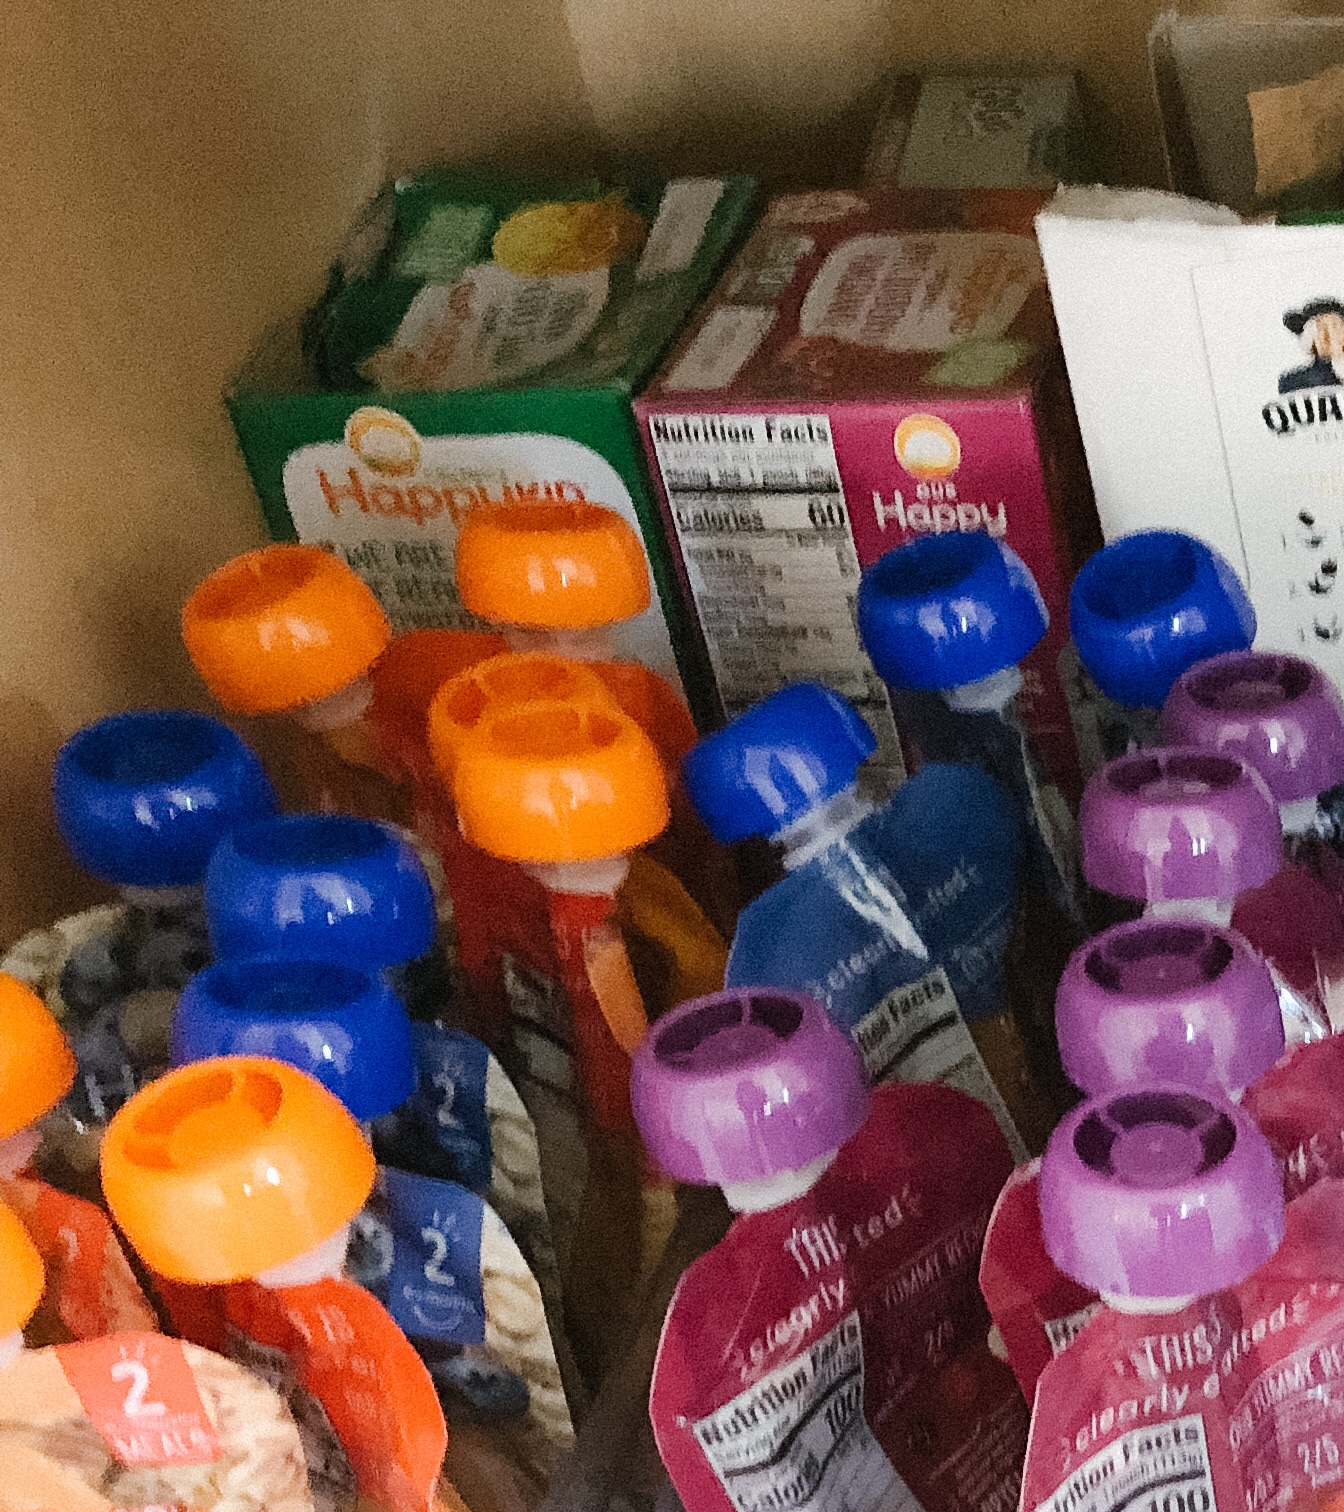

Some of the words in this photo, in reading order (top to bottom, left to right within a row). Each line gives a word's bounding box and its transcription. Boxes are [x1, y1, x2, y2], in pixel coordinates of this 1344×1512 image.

[652, 415, 756, 444] Nutrition
[763, 414, 831, 443] Facts
[872, 488, 1008, 537] Happy
[422, 1227, 456, 1287] 2
[110, 1360, 168, 1418] 2
[700, 1366, 809, 1447] Nutrition
